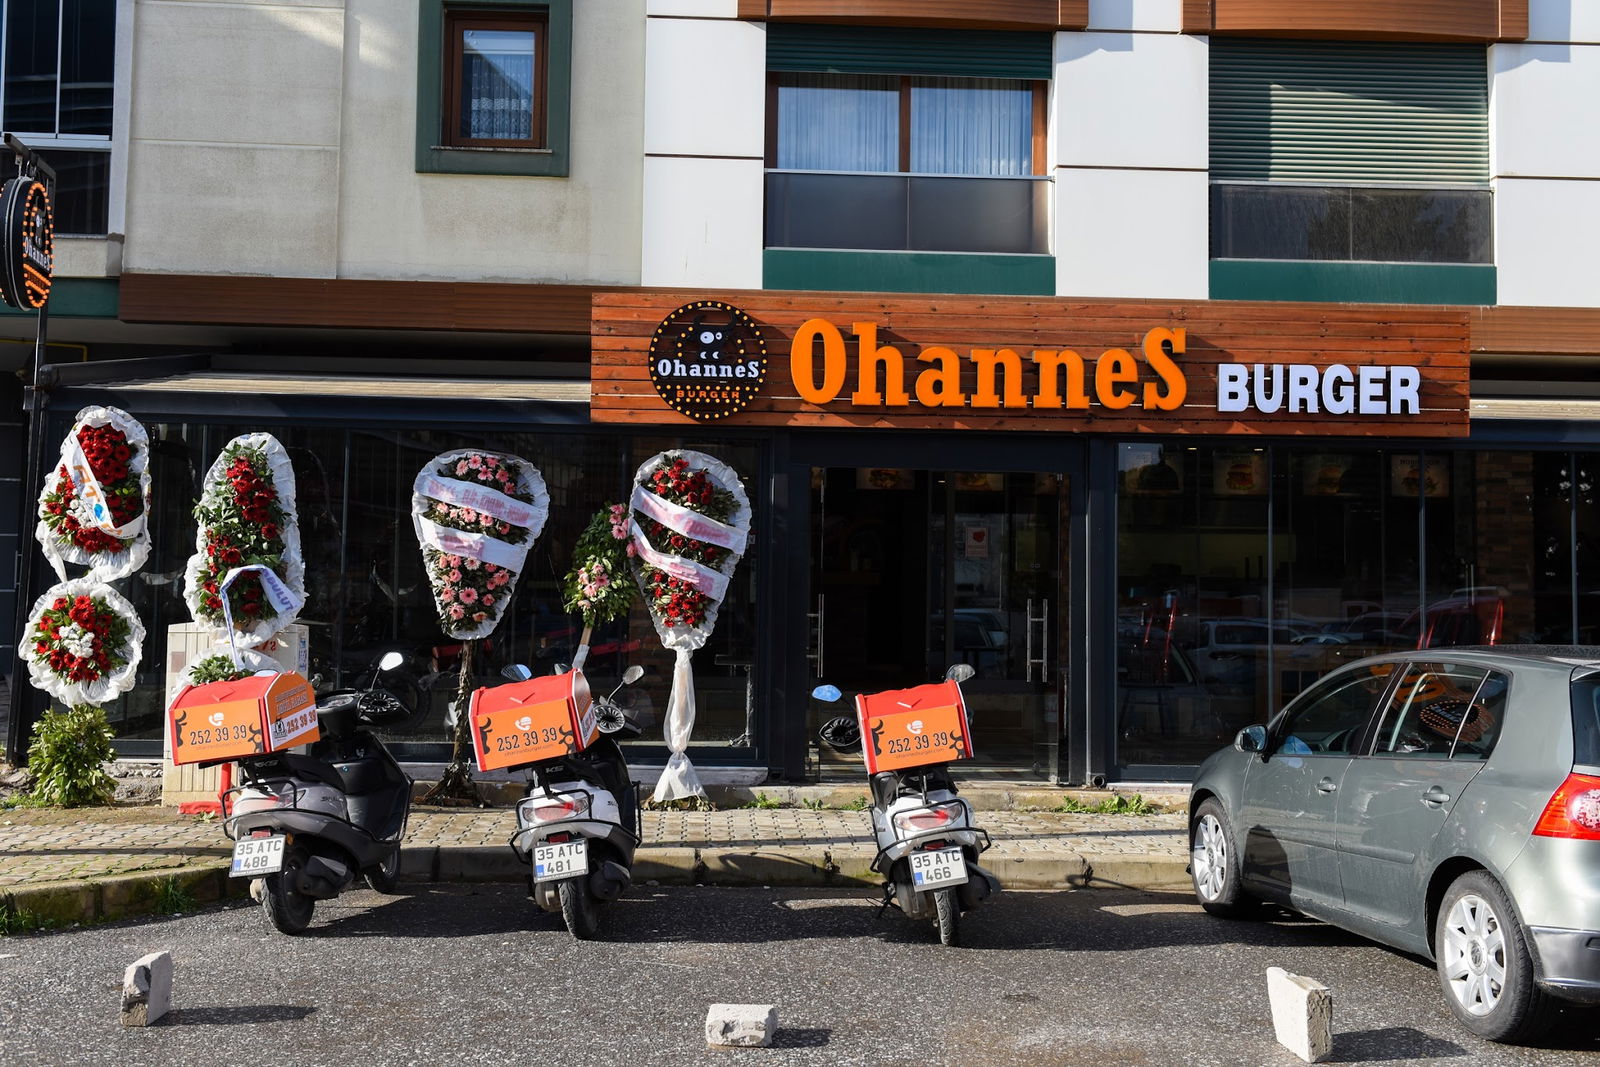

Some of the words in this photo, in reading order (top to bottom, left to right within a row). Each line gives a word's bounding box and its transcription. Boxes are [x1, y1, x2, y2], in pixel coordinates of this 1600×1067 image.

[657, 358, 760, 378] OhanneS
[790, 317, 1187, 411] OhanneS
[1216, 363, 1422, 415] BURGER
[676, 390, 741, 399] BURGER
[286, 717, 299, 734] 252
[190, 729, 212, 746] 252
[215, 726, 229, 743] 39
[233, 724, 247, 740] 39
[496, 734, 520, 752] 252
[523, 730, 539, 747] 39
[542, 727, 558, 743] 39
[888, 737, 911, 754] 252
[914, 734, 930, 750] 39
[933, 731, 948, 747] 39
[237, 843, 254, 856] 35
[257, 839, 282, 854] ATC
[537, 847, 554, 861] 35
[558, 842, 583, 858] ATC
[243, 855, 269, 869] 488
[547, 859, 571, 874] 481
[913, 855, 931, 868] 35
[935, 850, 961, 865] ATC
[925, 866, 952, 881] 466
